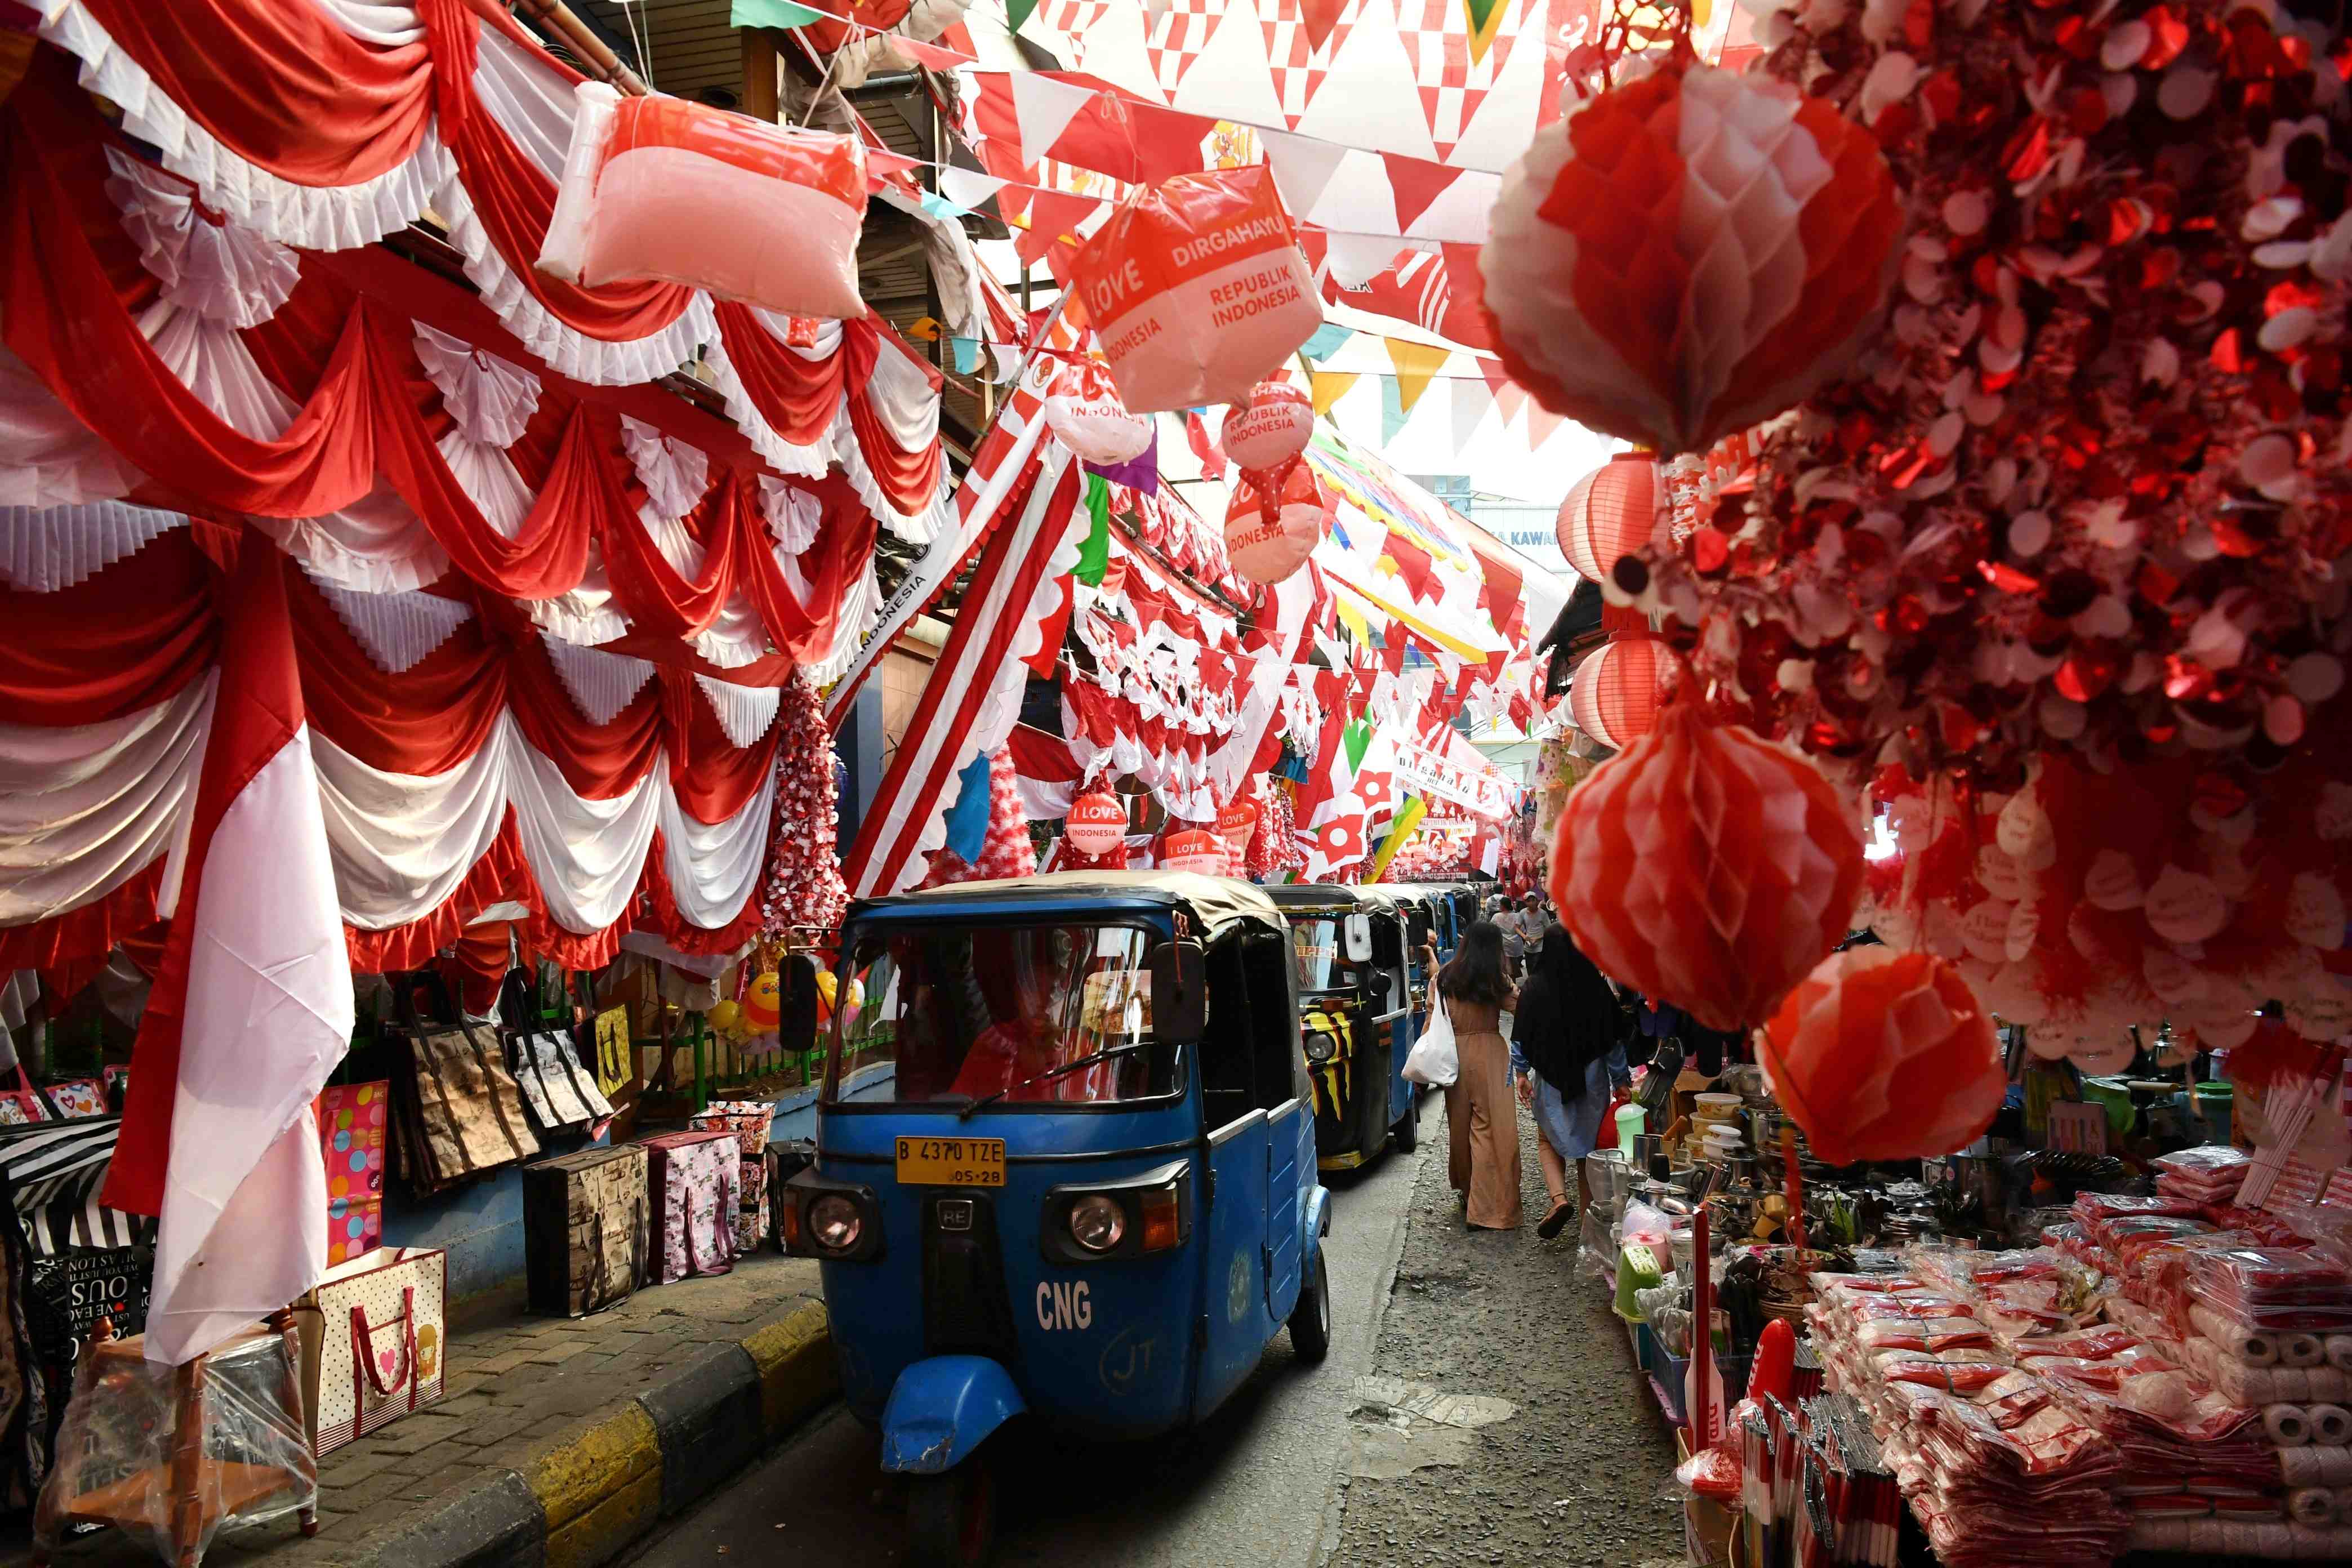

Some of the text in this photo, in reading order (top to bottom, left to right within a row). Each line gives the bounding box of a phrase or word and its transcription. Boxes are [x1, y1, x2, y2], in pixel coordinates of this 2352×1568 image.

[1171, 216, 1284, 267] DIRGAHAYU
[1090, 258, 1144, 318] LOVE
[1209, 265, 1292, 306] REPUBLIK
[1212, 285, 1301, 328] INDONESIA
[1230, 419, 1295, 446] INDONESIA
[1073, 806, 1118, 819] I LOVE
[1222, 813, 1244, 826] LOVE
[1170, 847, 1173, 856] I
[1177, 843, 1203, 854] LOVE
[899, 1141, 1001, 1162] B 4370 TZE
[943, 1210, 965, 1224] RE
[1037, 1280, 1092, 1330] CNG
